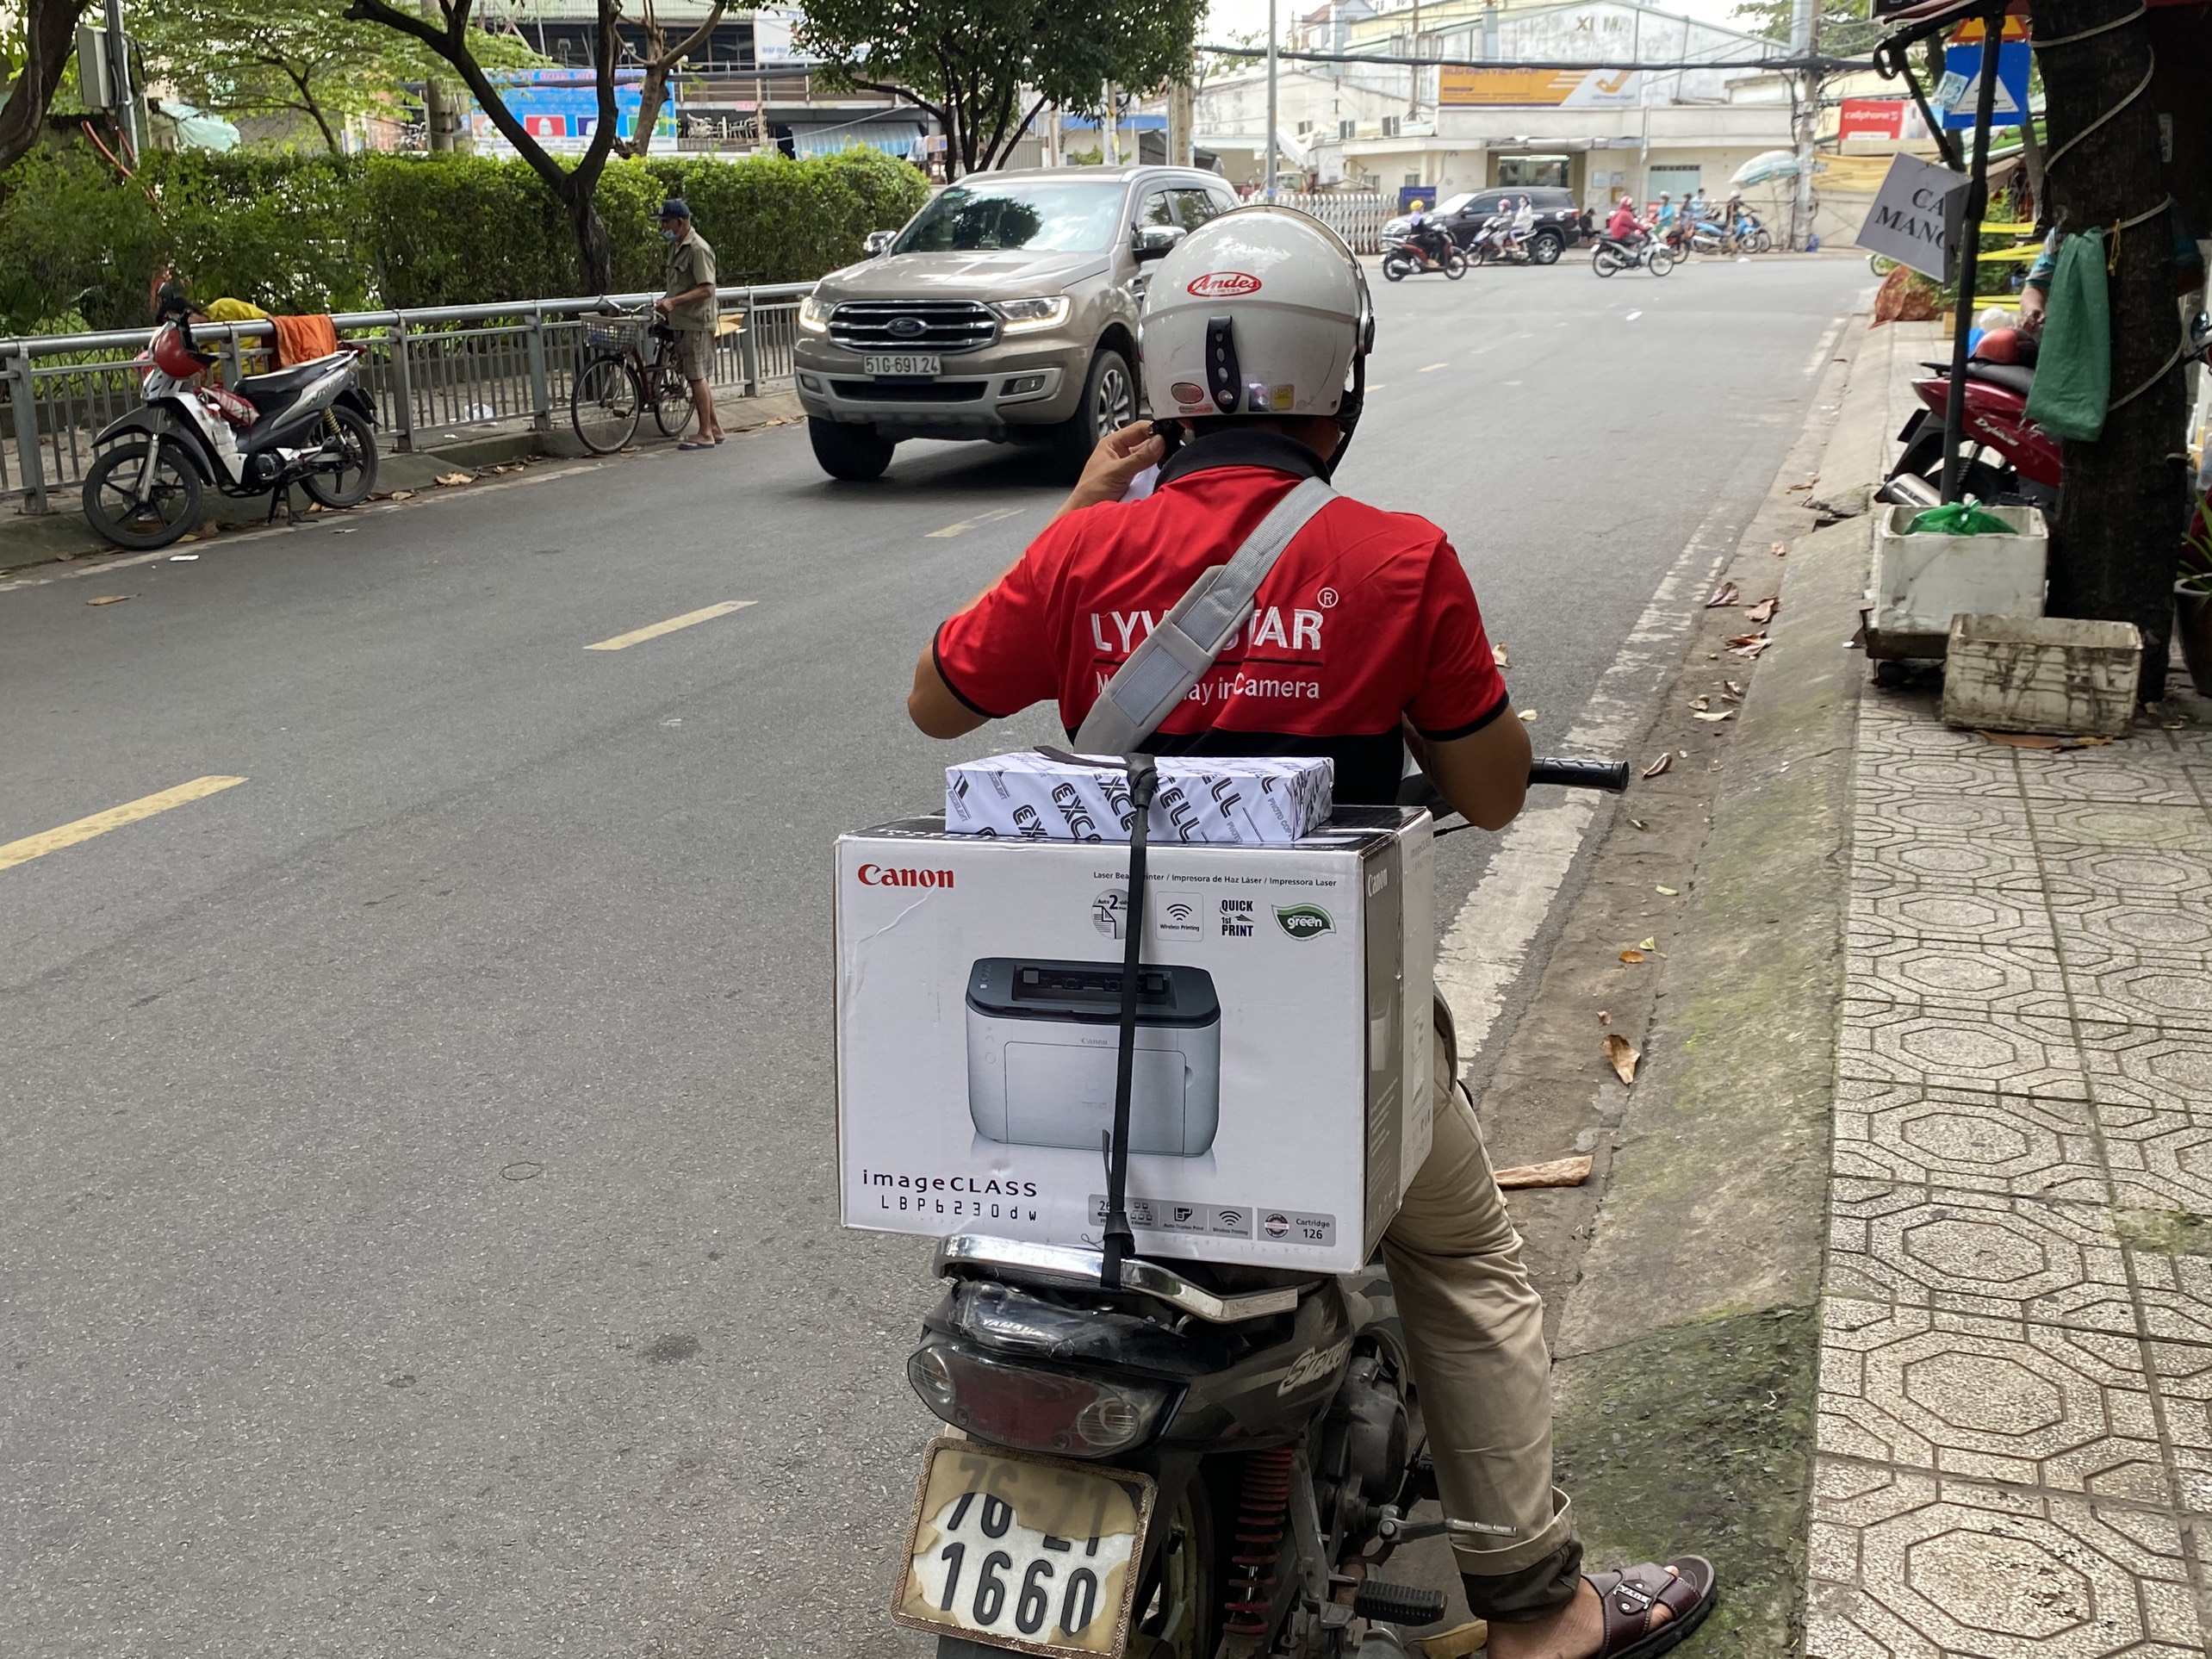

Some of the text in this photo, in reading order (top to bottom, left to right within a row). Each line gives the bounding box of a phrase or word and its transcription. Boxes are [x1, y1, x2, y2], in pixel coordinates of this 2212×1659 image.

[1193, 275, 1258, 291] Andes
[866, 357, 939, 373] 51G-691.24
[1233, 672, 1320, 700] Camera
[858, 864, 954, 888] Canon
[1171, 874, 1210, 883] Impresora
[1224, 875, 1240, 884] Haz
[1270, 878, 1314, 886] Impressora
[1315, 879, 1337, 887] Laser
[1368, 867, 1388, 898] Canon
[1109, 894, 1118, 910] 2
[1221, 899, 1253, 912] QUICK
[1221, 924, 1254, 937] PRINT
[1287, 917, 1323, 929] green
[1081, 1037, 1108, 1047] Canon
[863, 1169, 1037, 1198] imageCLASS
[1296, 1218, 1331, 1228] Cartridge
[1302, 1228, 1323, 1240] 126
[940, 1541, 1098, 1637] 1660
